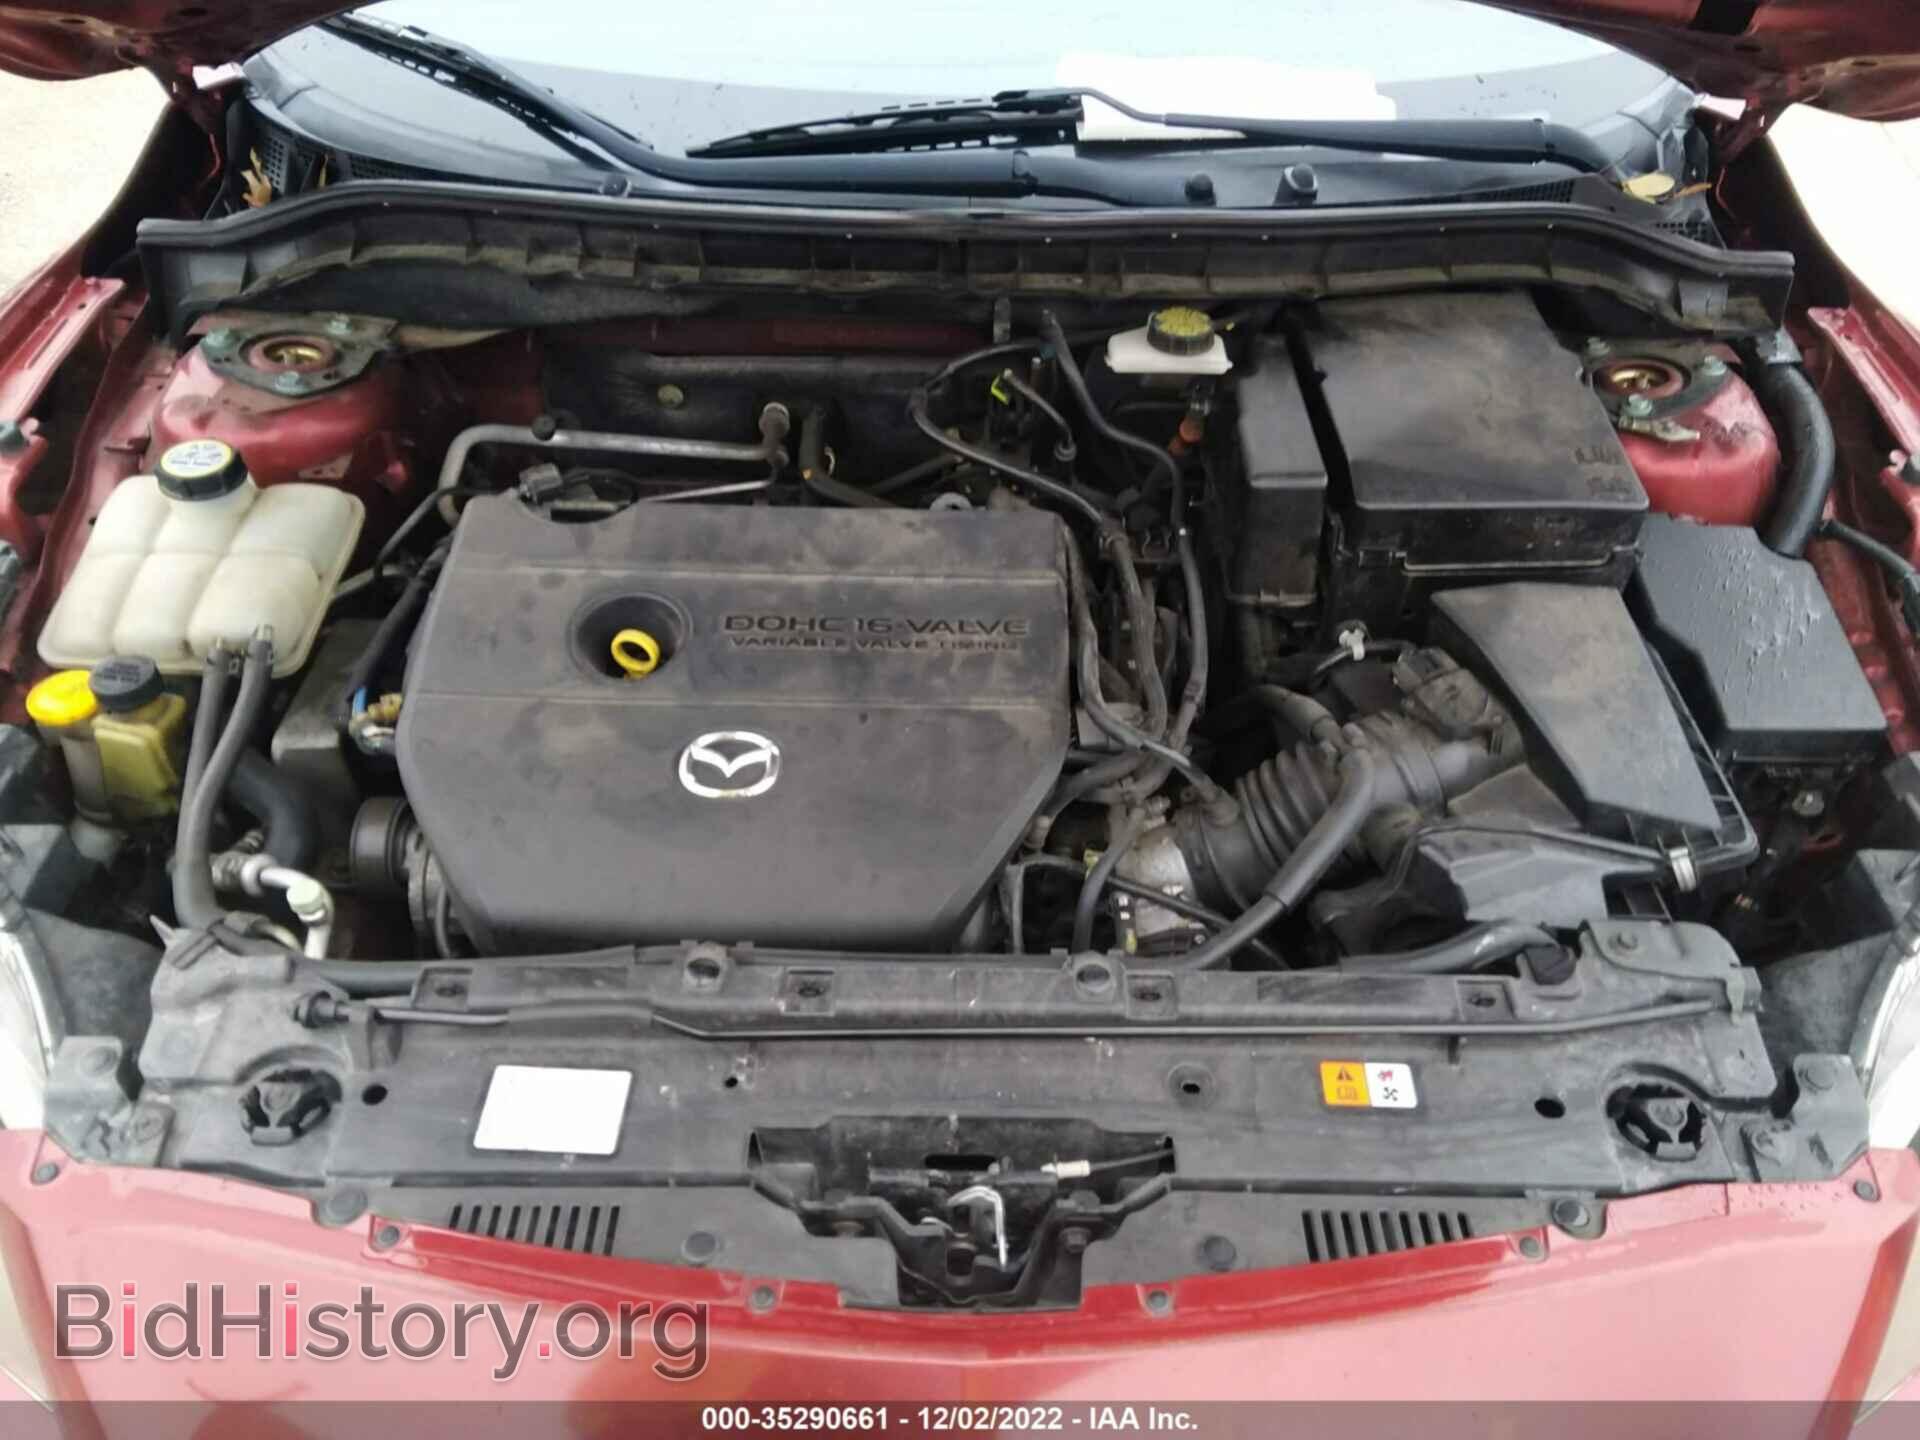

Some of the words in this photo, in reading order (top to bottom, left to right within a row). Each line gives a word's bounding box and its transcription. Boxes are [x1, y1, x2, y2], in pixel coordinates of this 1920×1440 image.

[725, 615, 847, 631] DOHC
[732, 637, 848, 648] VARIABLE
[857, 639, 928, 649] VALVE
